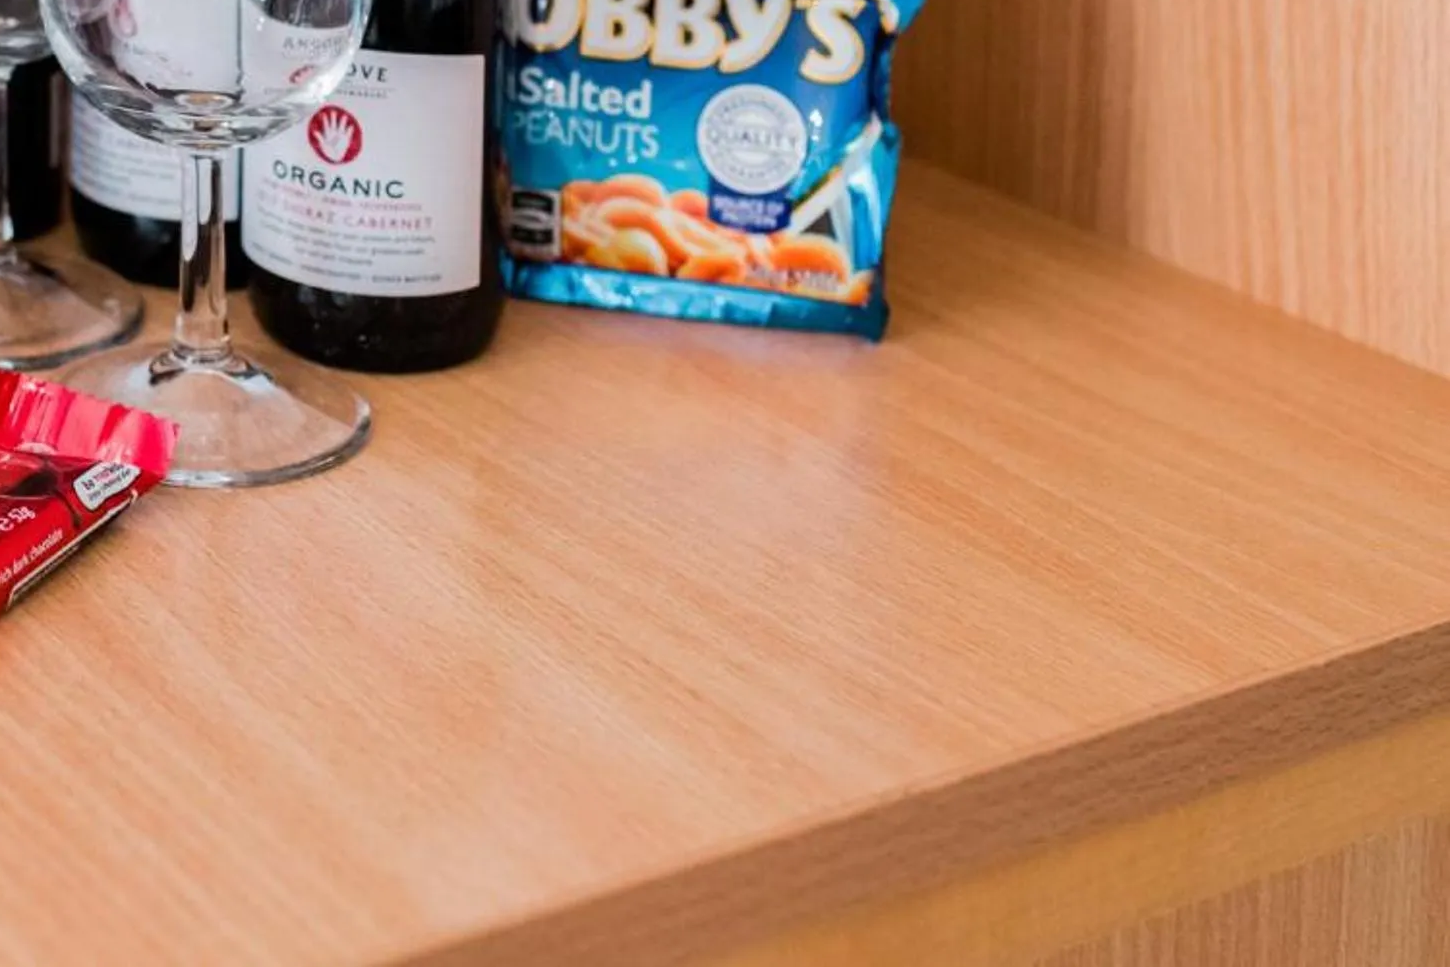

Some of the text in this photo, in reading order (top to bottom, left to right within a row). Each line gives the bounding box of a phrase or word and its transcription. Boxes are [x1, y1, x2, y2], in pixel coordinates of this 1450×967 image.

[518, 66, 653, 118] Salted
[513, 109, 660, 161] PEANUTS
[272, 159, 405, 200] ORGANIC
